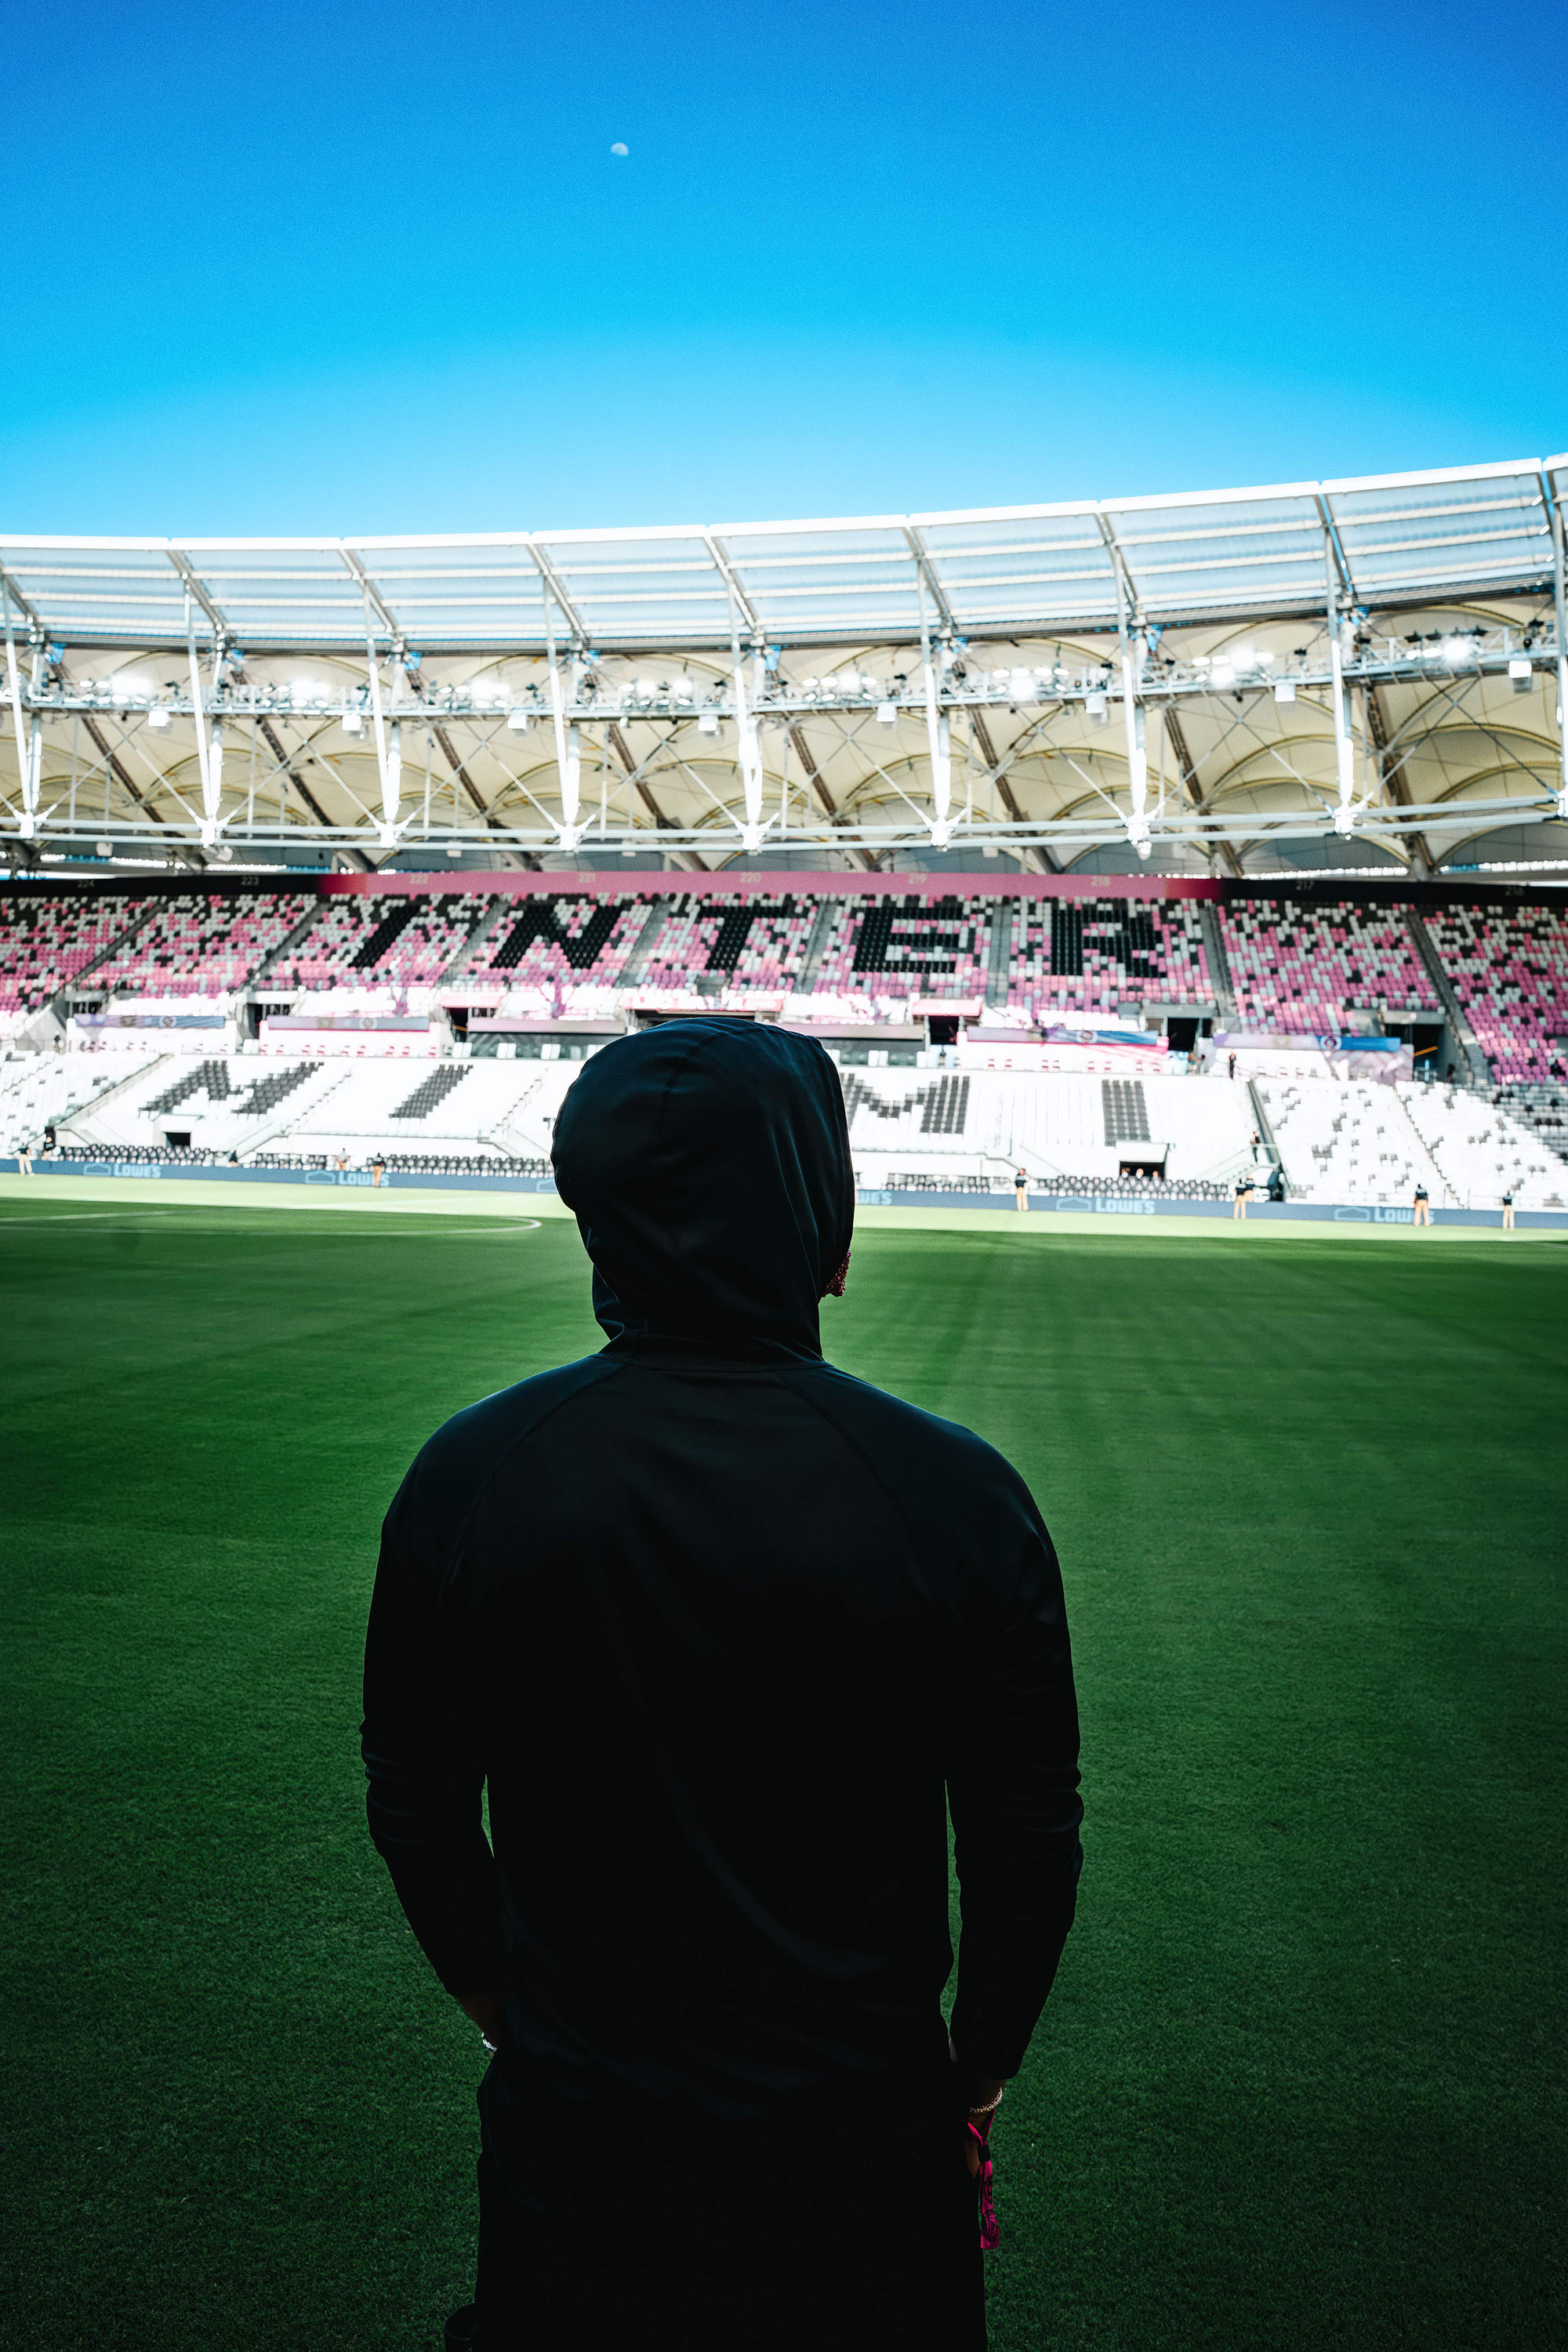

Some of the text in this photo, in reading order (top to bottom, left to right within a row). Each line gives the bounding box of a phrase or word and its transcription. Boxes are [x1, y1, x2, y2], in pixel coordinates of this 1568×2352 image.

[241, 876, 260, 886] 223
[348, 904, 1167, 978] INTER
[139, 1060, 1151, 1146] MIMI
